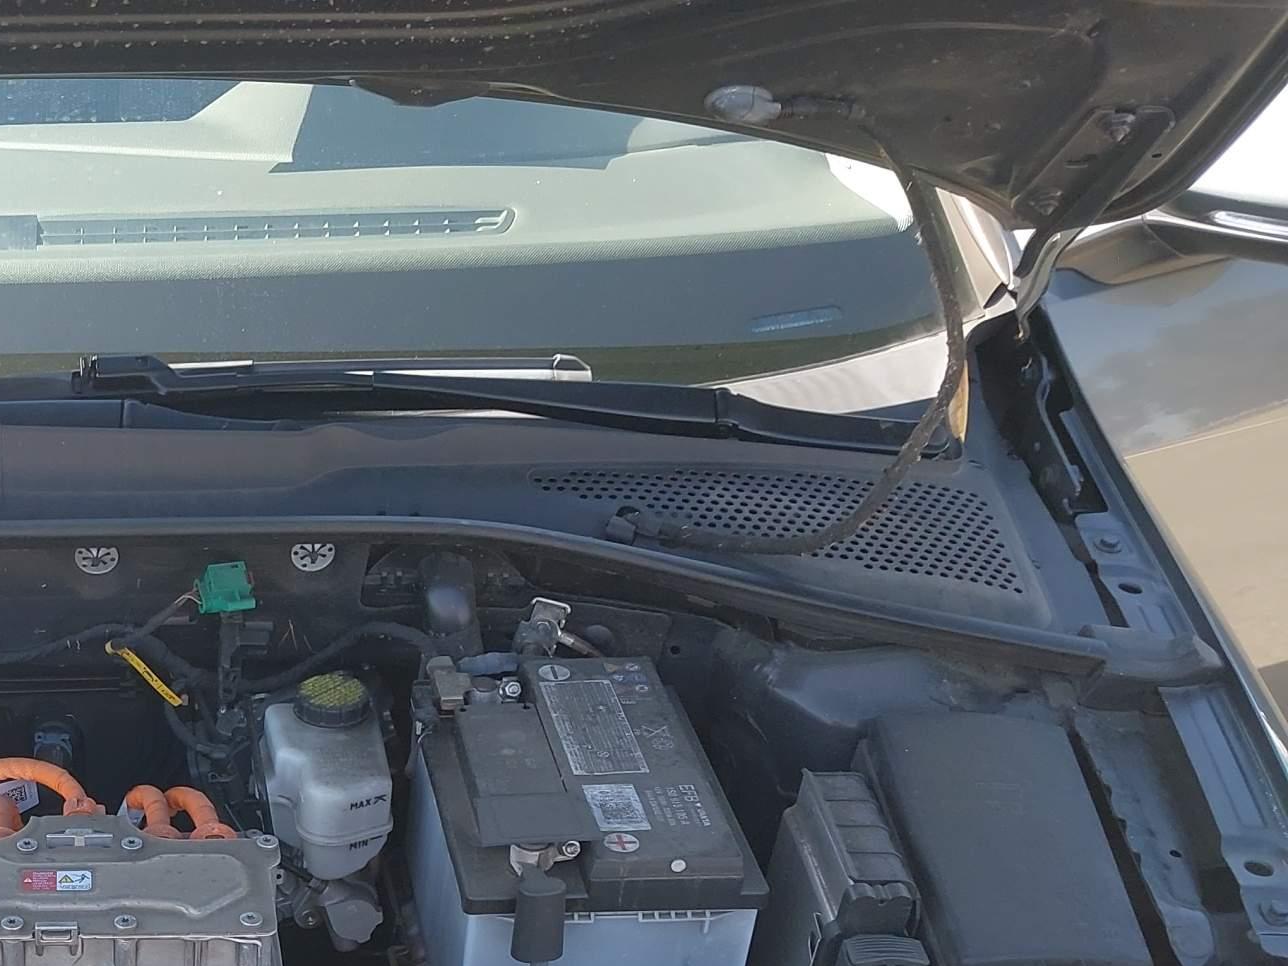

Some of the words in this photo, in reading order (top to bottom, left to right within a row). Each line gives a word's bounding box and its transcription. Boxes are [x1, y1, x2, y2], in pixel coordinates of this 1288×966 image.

[678, 784, 699, 801] EFB
[350, 799, 372, 811] MAX
[349, 839, 369, 851] MIN
